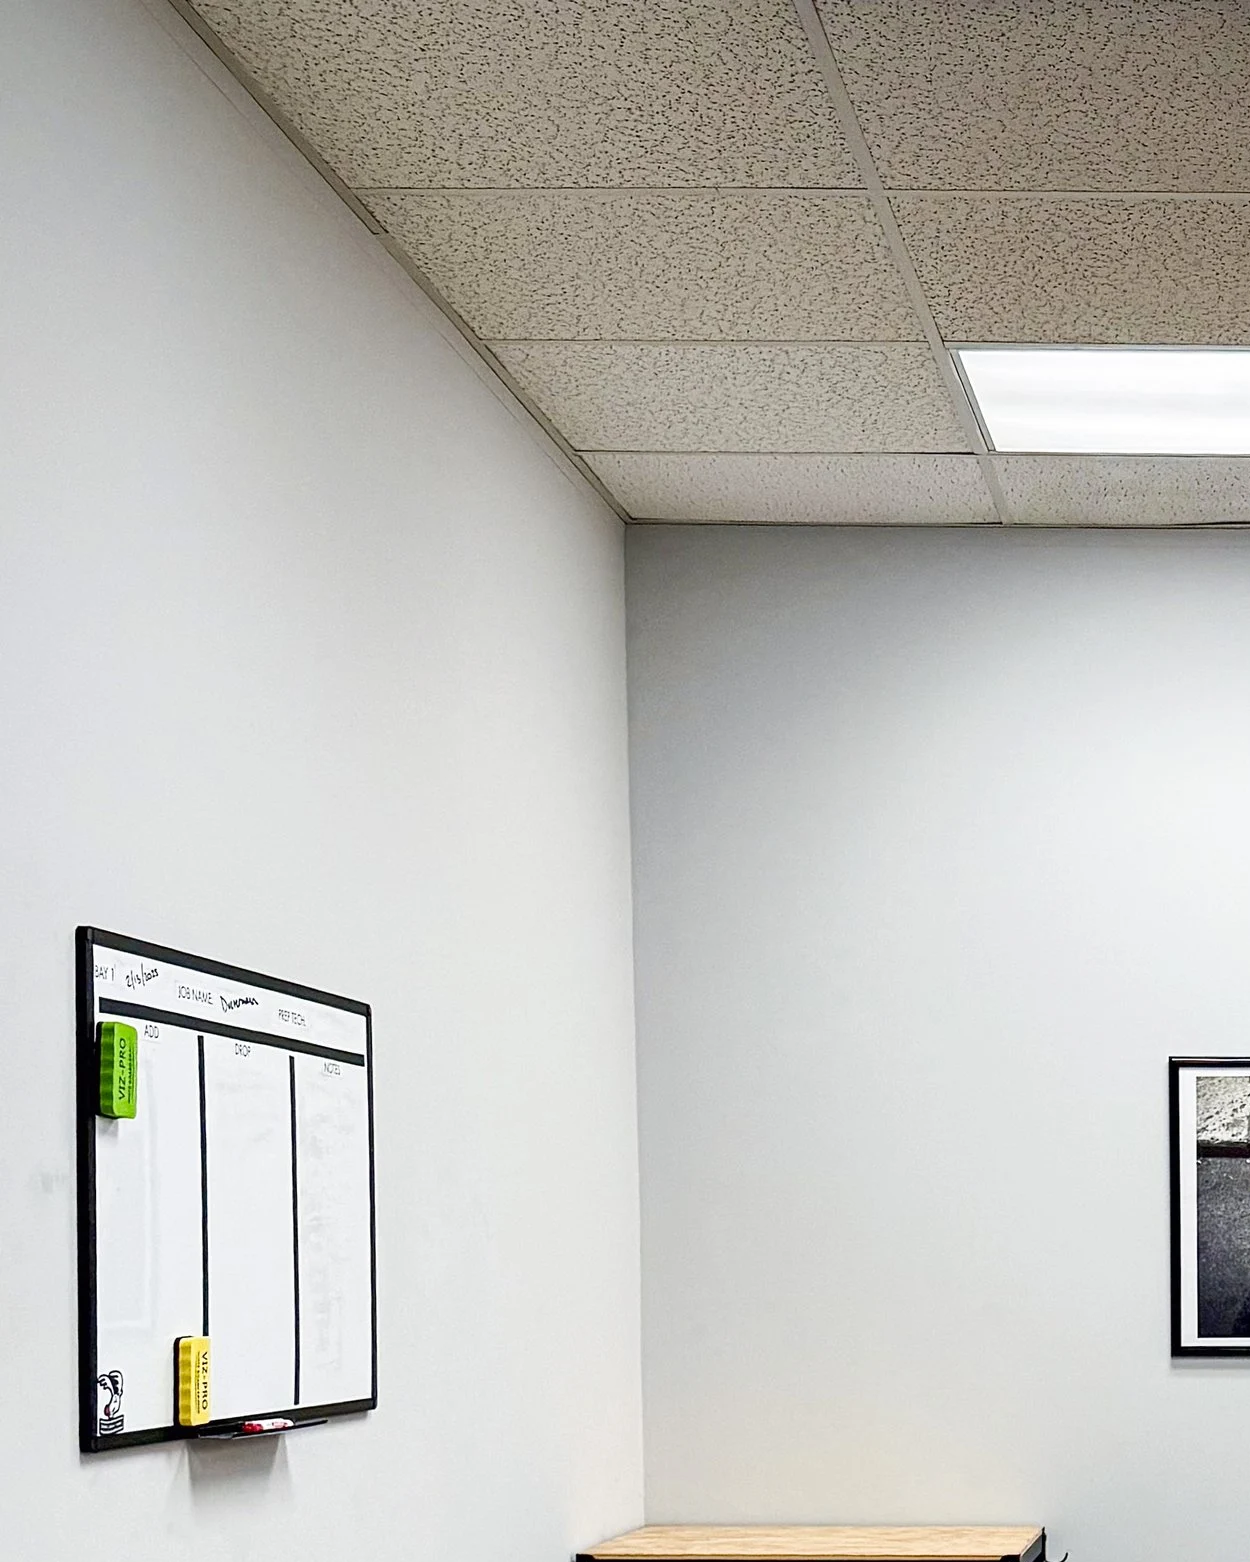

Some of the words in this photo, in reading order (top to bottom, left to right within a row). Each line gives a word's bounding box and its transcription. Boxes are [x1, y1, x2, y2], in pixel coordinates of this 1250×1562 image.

[178, 985, 191, 1000] JOB
[144, 1024, 160, 1039] ADD
[234, 1042, 251, 1057] DROP
[118, 1037, 127, 1101] VIZ-PRO
